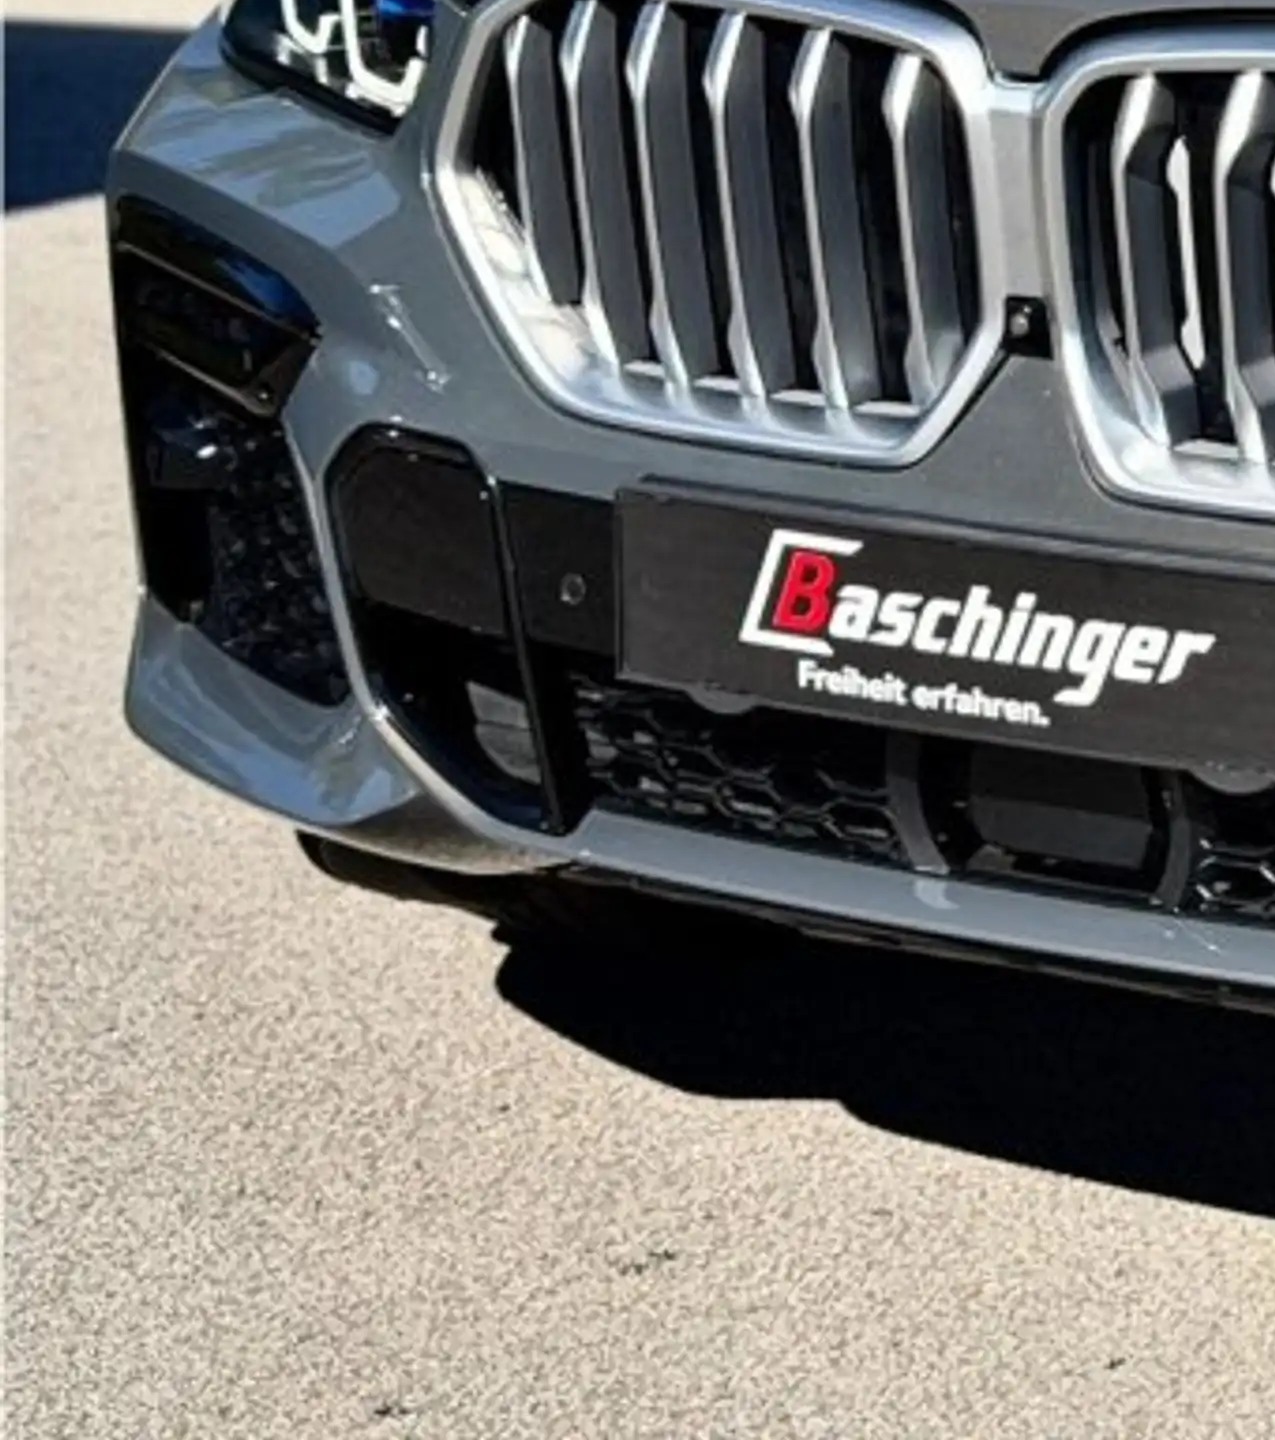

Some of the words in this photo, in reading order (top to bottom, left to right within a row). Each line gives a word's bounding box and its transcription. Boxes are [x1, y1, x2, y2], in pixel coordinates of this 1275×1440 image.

[772, 550, 1216, 706] Baschinger
[797, 660, 908, 706] Freiheit
[911, 683, 1051, 727] erfahren.
